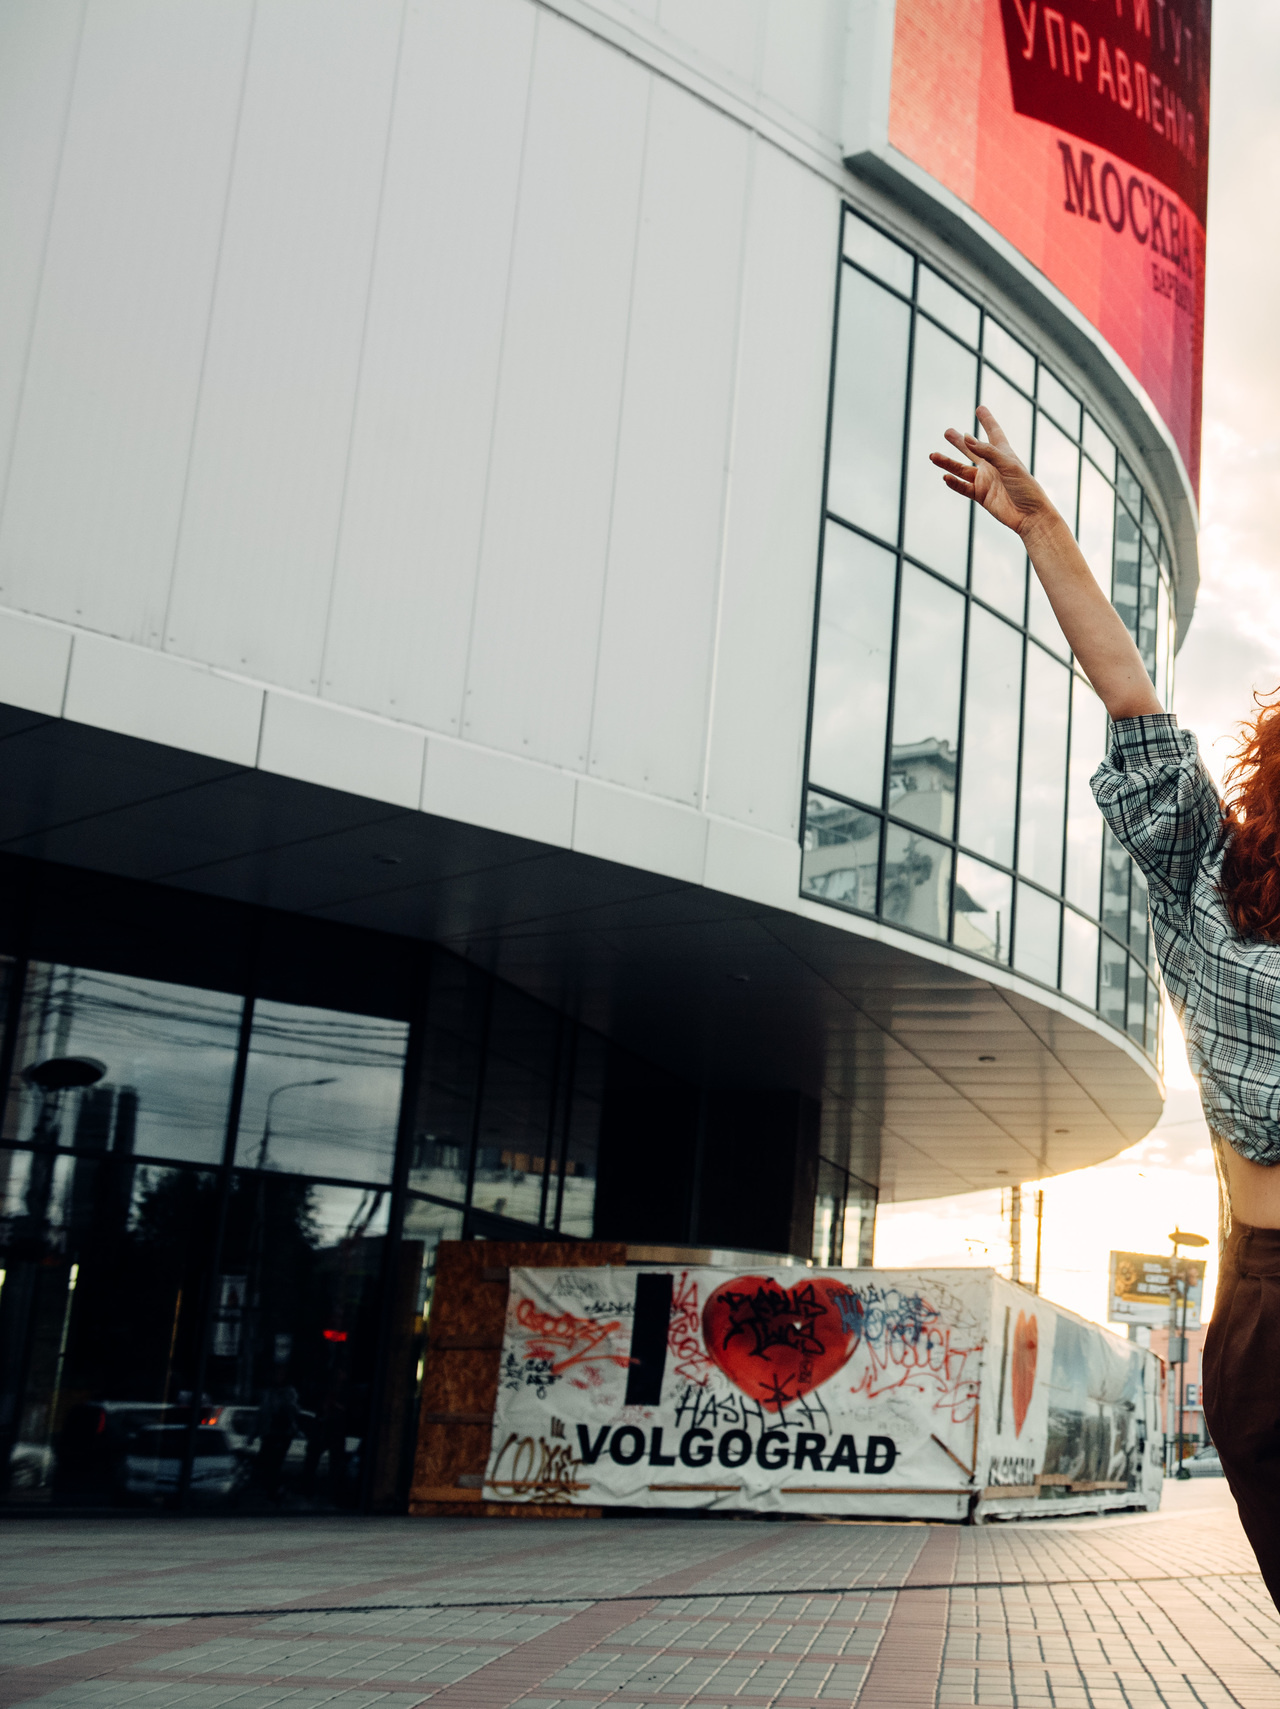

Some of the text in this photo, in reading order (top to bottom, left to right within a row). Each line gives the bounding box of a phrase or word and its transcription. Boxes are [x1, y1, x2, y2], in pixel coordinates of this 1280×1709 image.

[1057, 139, 1194, 279] МОСКВА
[624, 1273, 674, 1406] I
[576, 1423, 897, 1476] VOLGOGRAD
